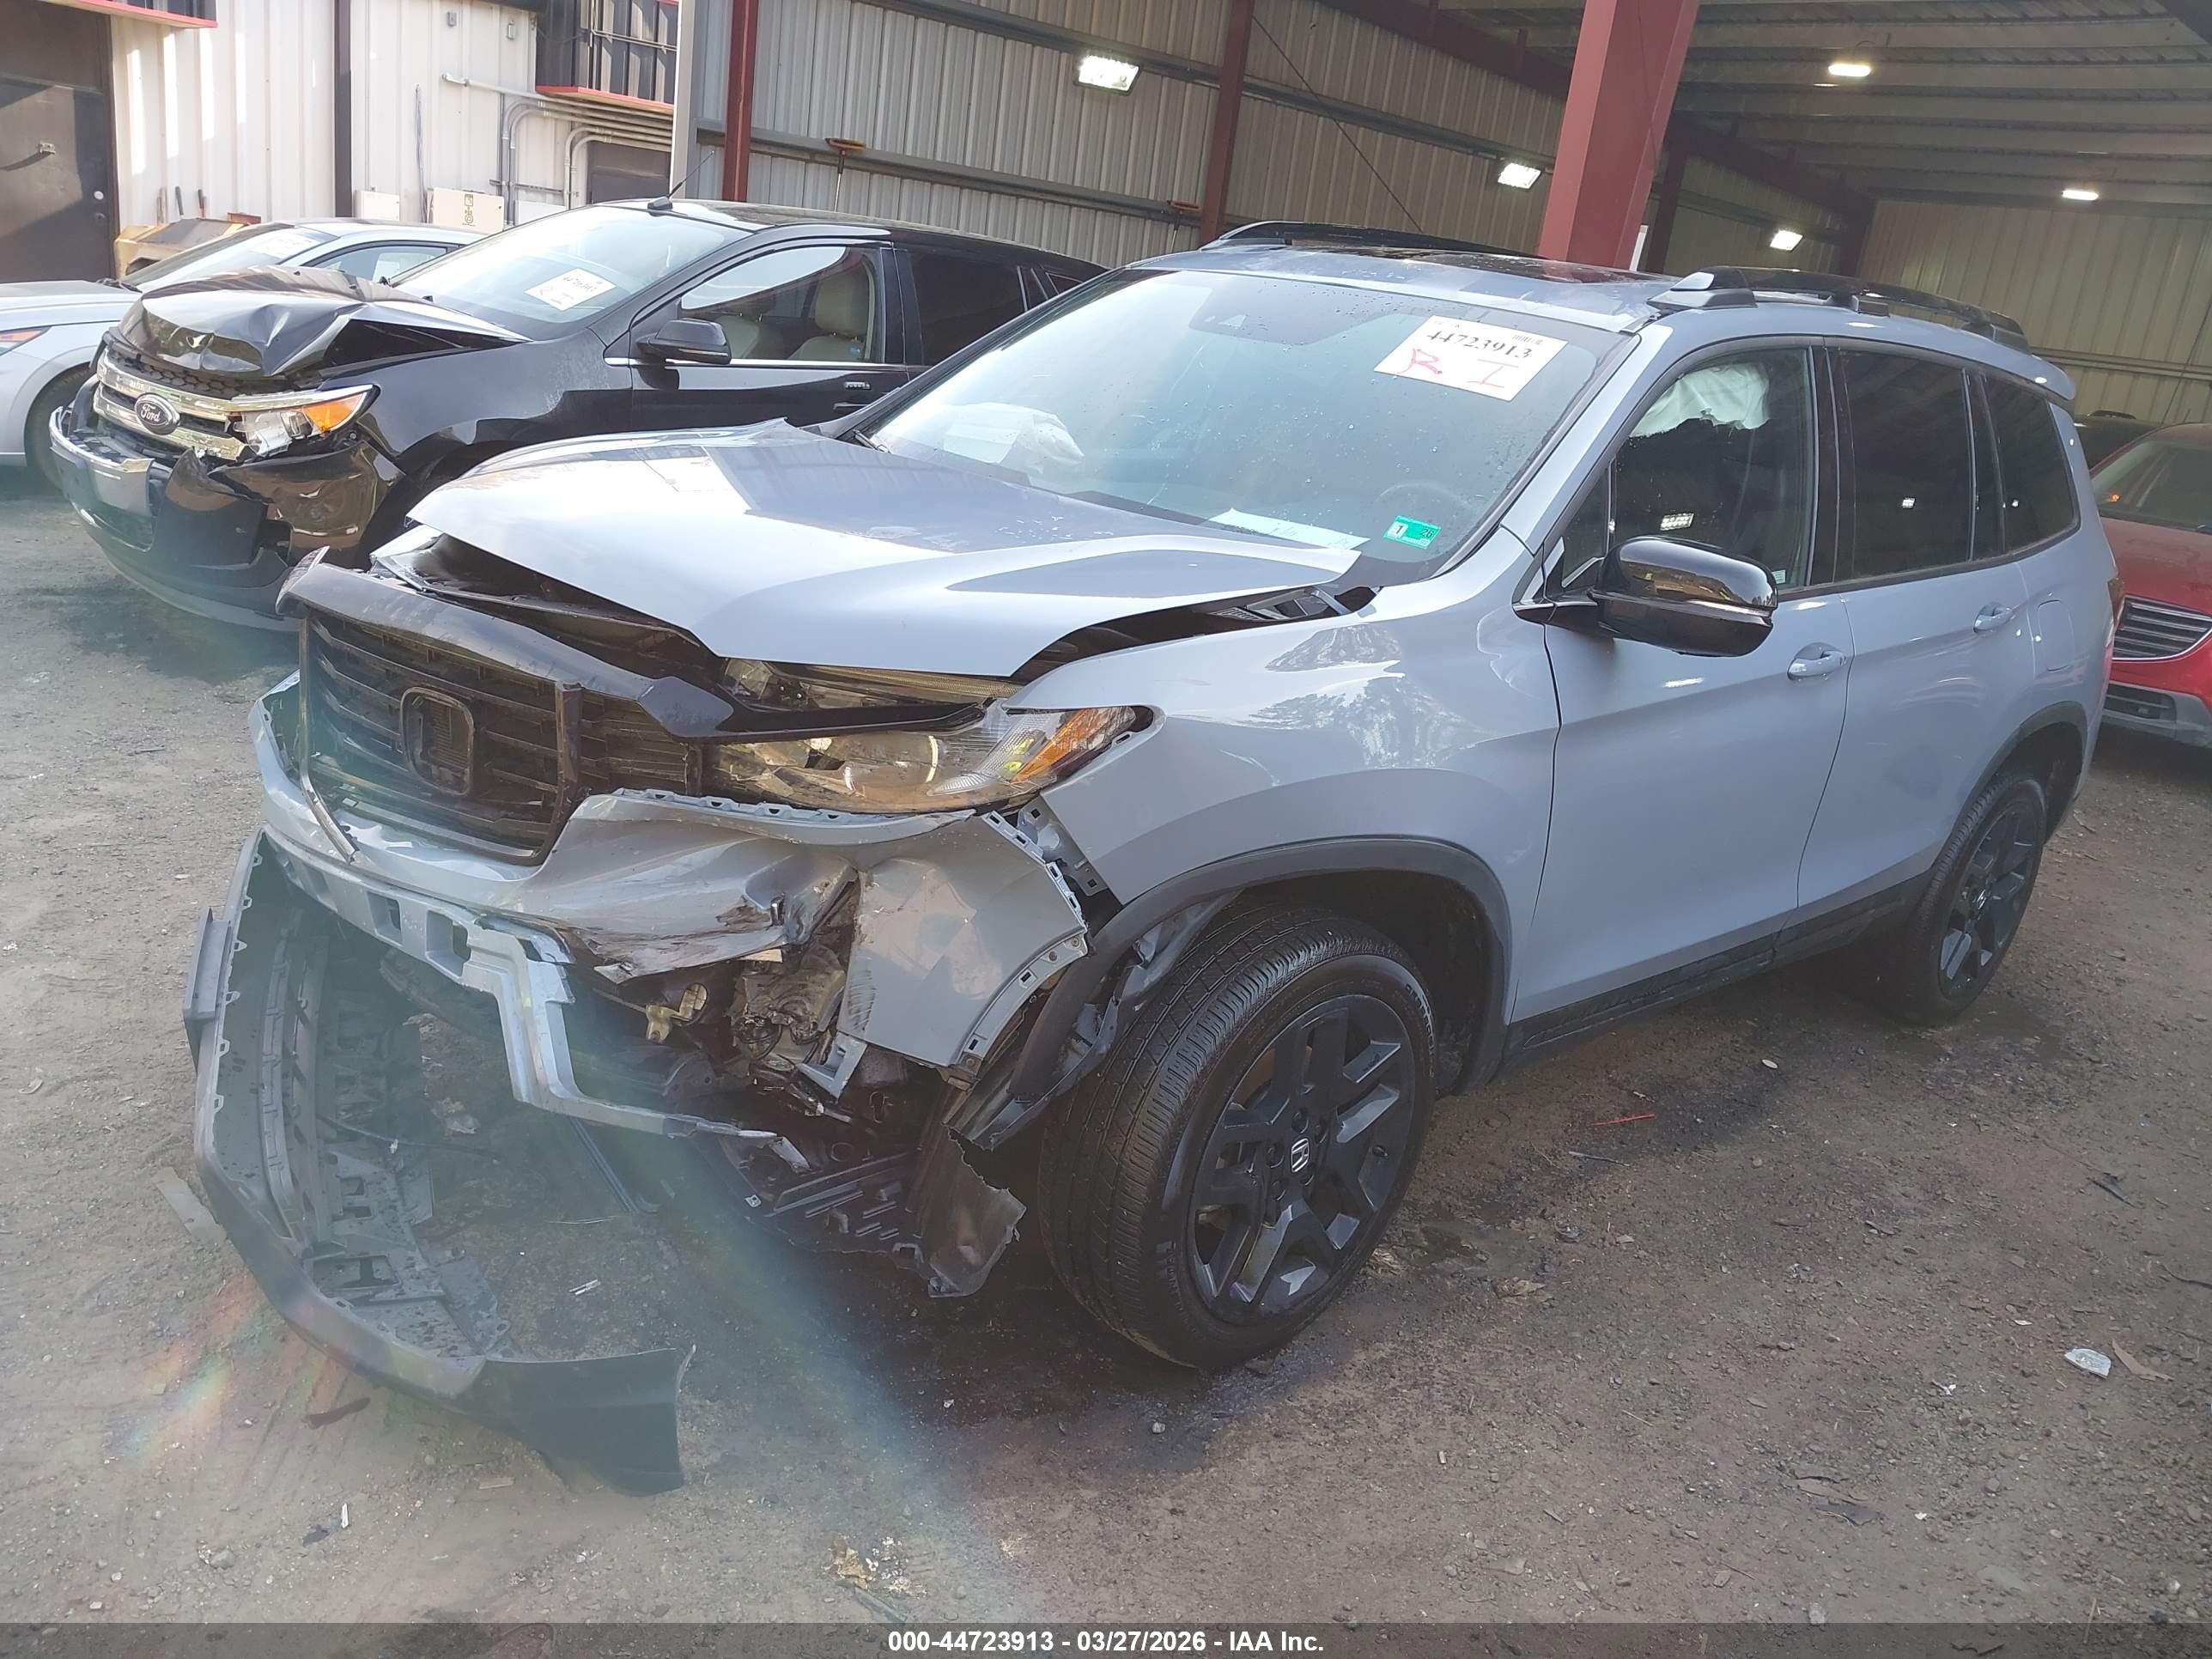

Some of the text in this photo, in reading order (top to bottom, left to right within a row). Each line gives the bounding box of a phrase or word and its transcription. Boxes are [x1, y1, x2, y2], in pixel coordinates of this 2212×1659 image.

[1426, 331, 1533, 359] 44723913
[1396, 348, 1443, 375] R
[140, 403, 161, 422] Ford
